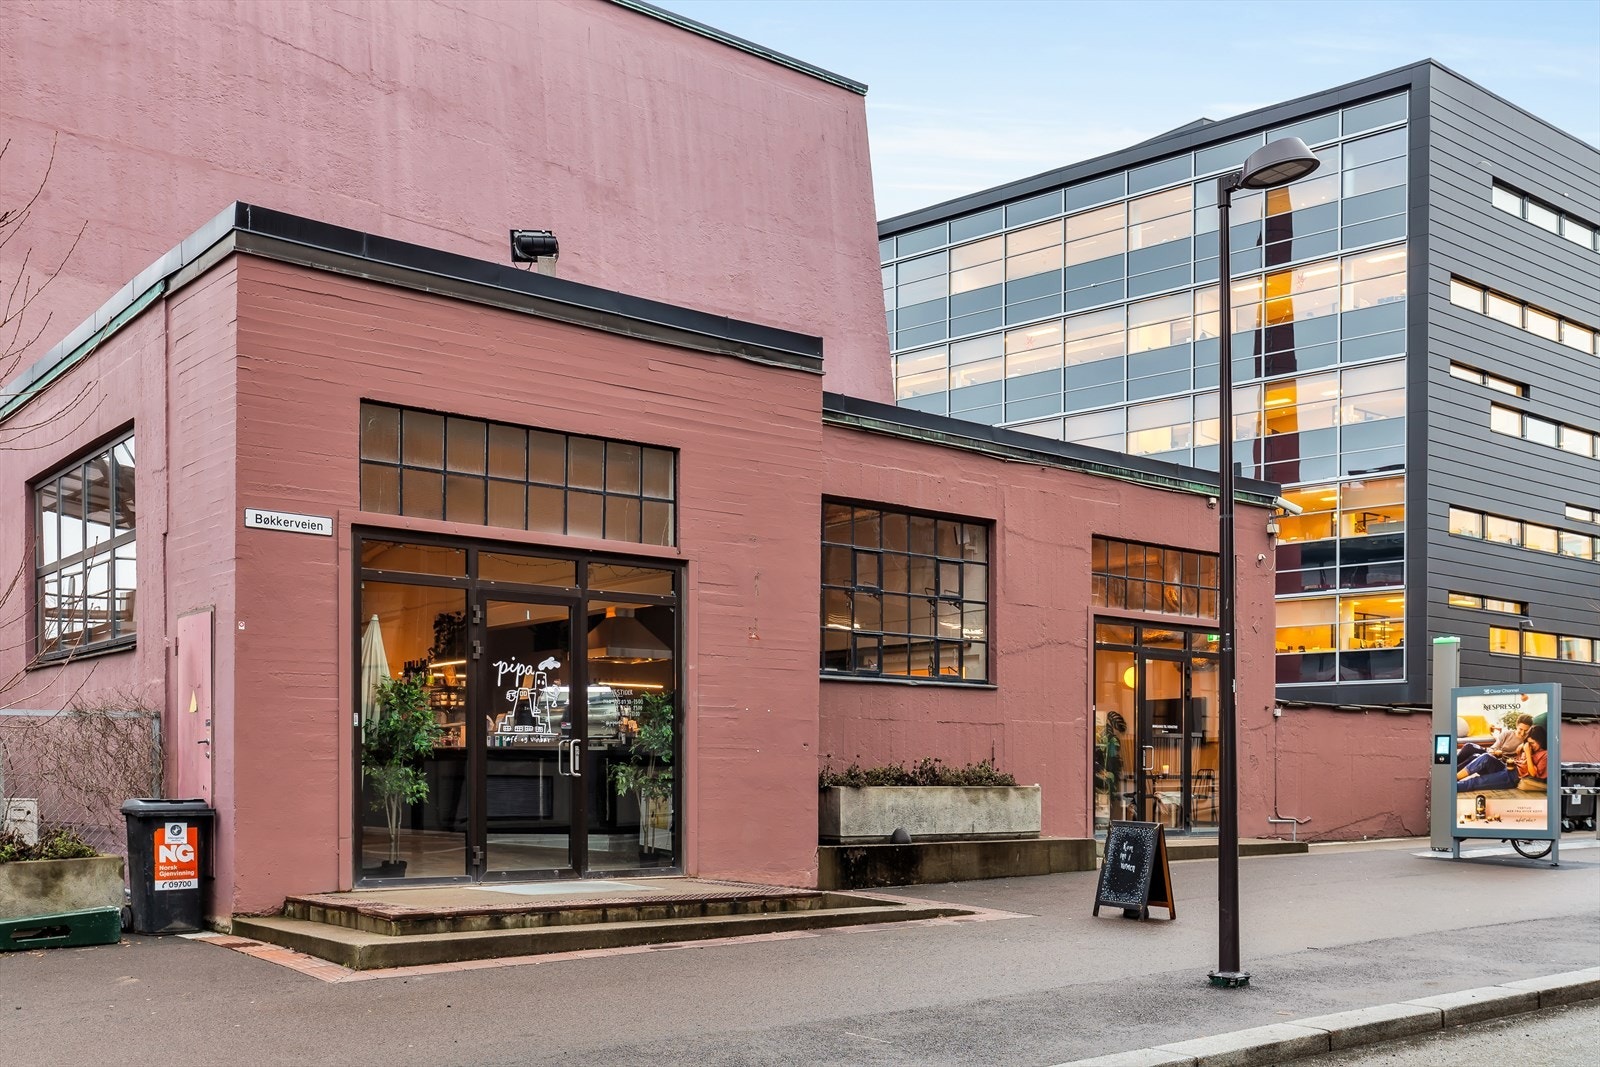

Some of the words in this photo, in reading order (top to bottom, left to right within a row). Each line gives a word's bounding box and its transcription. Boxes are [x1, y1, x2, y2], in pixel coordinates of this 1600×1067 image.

[255, 514, 323, 531] Bøkkerveien
[492, 656, 535, 687] pipa
[1483, 703, 1521, 711] NESPRESSO
[159, 844, 194, 863] NG
